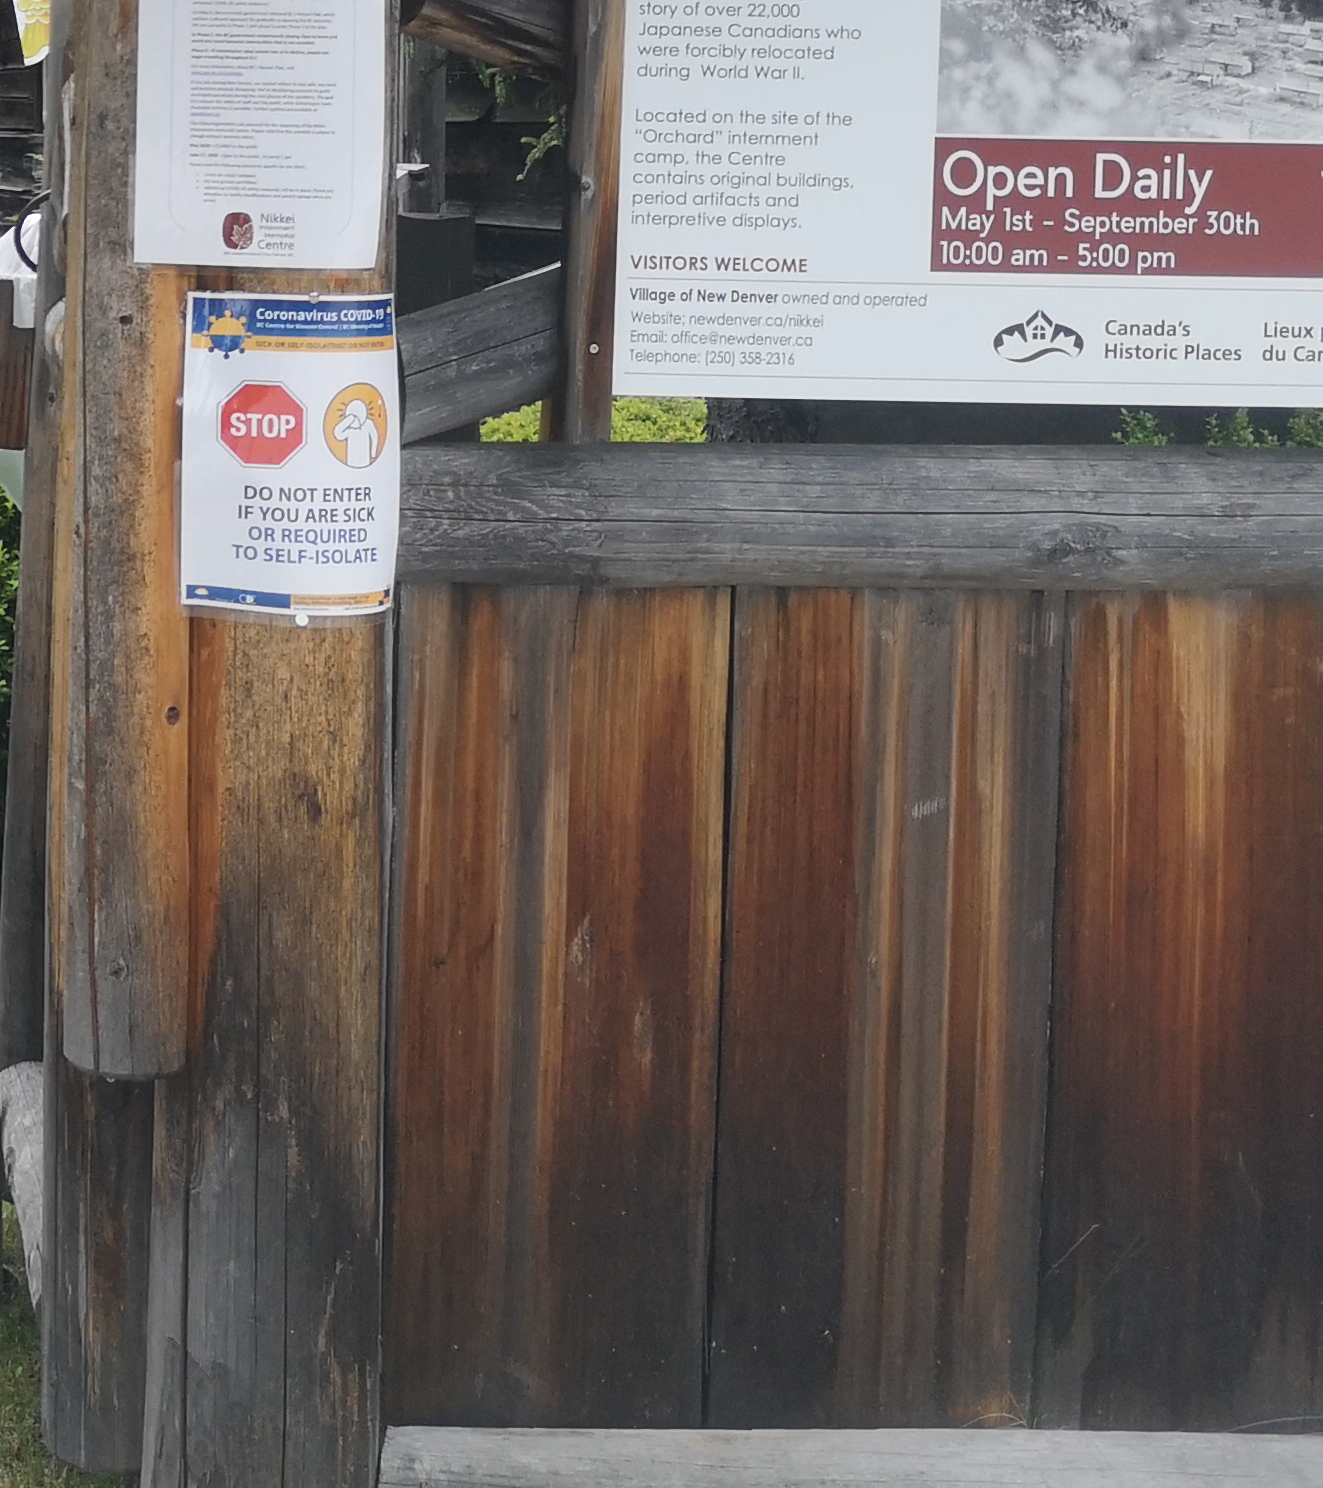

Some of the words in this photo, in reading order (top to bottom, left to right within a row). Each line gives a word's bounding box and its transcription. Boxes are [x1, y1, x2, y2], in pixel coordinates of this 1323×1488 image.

[639, 2, 678, 18] story
[683, 2, 699, 16] of
[705, 5, 742, 17] over
[747, 3, 800, 19] 22,000
[638, 22, 722, 39] Japanese
[727, 23, 821, 39] Canadians
[825, 26, 862, 40] who
[637, 45, 679, 57] were
[685, 43, 746, 61] forcibly
[751, 46, 835, 60] relocated
[637, 64, 690, 81] during
[700, 64, 749, 79] World
[755, 66, 787, 79] War
[792, 67, 804, 80] II.
[635, 108, 706, 123] Located
[712, 113, 733, 124] on
[739, 110, 765, 124] the
[771, 111, 798, 125] site
[804, 111, 821, 125] of
[826, 112, 853, 126] the
[727, 130, 819, 146] internment
[633, 151, 689, 167] camp,
[695, 151, 722, 165] the
[727, 152, 786, 166] Centre
[632, 171, 705, 185] contains
[710, 172, 771, 189] original
[777, 173, 854, 190] buildings,
[942, 150, 1074, 210] Open
[1094, 153, 1213, 214] Daily
[632, 191, 687, 207] period
[692, 192, 760, 207] artifacts
[765, 194, 799, 207] and
[260, 213, 295, 223] Nikkei
[630, 212, 727, 228] interpretive
[732, 214, 802, 230] displays.
[941, 207, 995, 237] May
[1004, 208, 1033, 231] 1st
[1064, 209, 1198, 238] September
[1204, 212, 1259, 235] 30th
[257, 240, 294, 250] Centre
[630, 255, 708, 271] VISITORS
[715, 257, 808, 272] WELCOME
[940, 241, 1003, 265] 10:00
[1011, 247, 1048, 266] am
[1078, 244, 1129, 267] 5:00
[1137, 249, 1176, 274] pm
[629, 287, 676, 304] Village
[680, 289, 693, 302] of
[697, 289, 727, 303] New
[731, 290, 778, 303] Denver
[782, 293, 829, 306] owned
[833, 293, 859, 306] and
[863, 294, 927, 308] operated
[256, 308, 338, 321] Coronavirus
[341, 308, 384, 321] COVID-19
[689, 314, 824, 328] newdenver.ca/nikkei
[630, 330, 668, 344] Email:
[671, 331, 813, 347] office@newdenver.ca
[1264, 322, 1313, 338] Lieux
[629, 349, 701, 364] Telephone:
[705, 350, 736, 366] (250)
[739, 352, 795, 365] 358-2316
[1104, 344, 1178, 360] Historic
[1184, 345, 1242, 362] Places
[1262, 345, 1286, 361] du
[230, 412, 296, 438] STOP
[244, 485, 273, 501] DO
[279, 487, 318, 503] NOT
[323, 487, 372, 502] ENTER
[238, 505, 254, 519] IF
[259, 506, 299, 523] YOU
[305, 508, 338, 523] ARE
[343, 507, 375, 522] SICK
[248, 526, 275, 543] OR
[281, 527, 367, 545] REQUIRED
[231, 544, 257, 562] TO
[264, 545, 378, 564] SELF-ISOLATE
